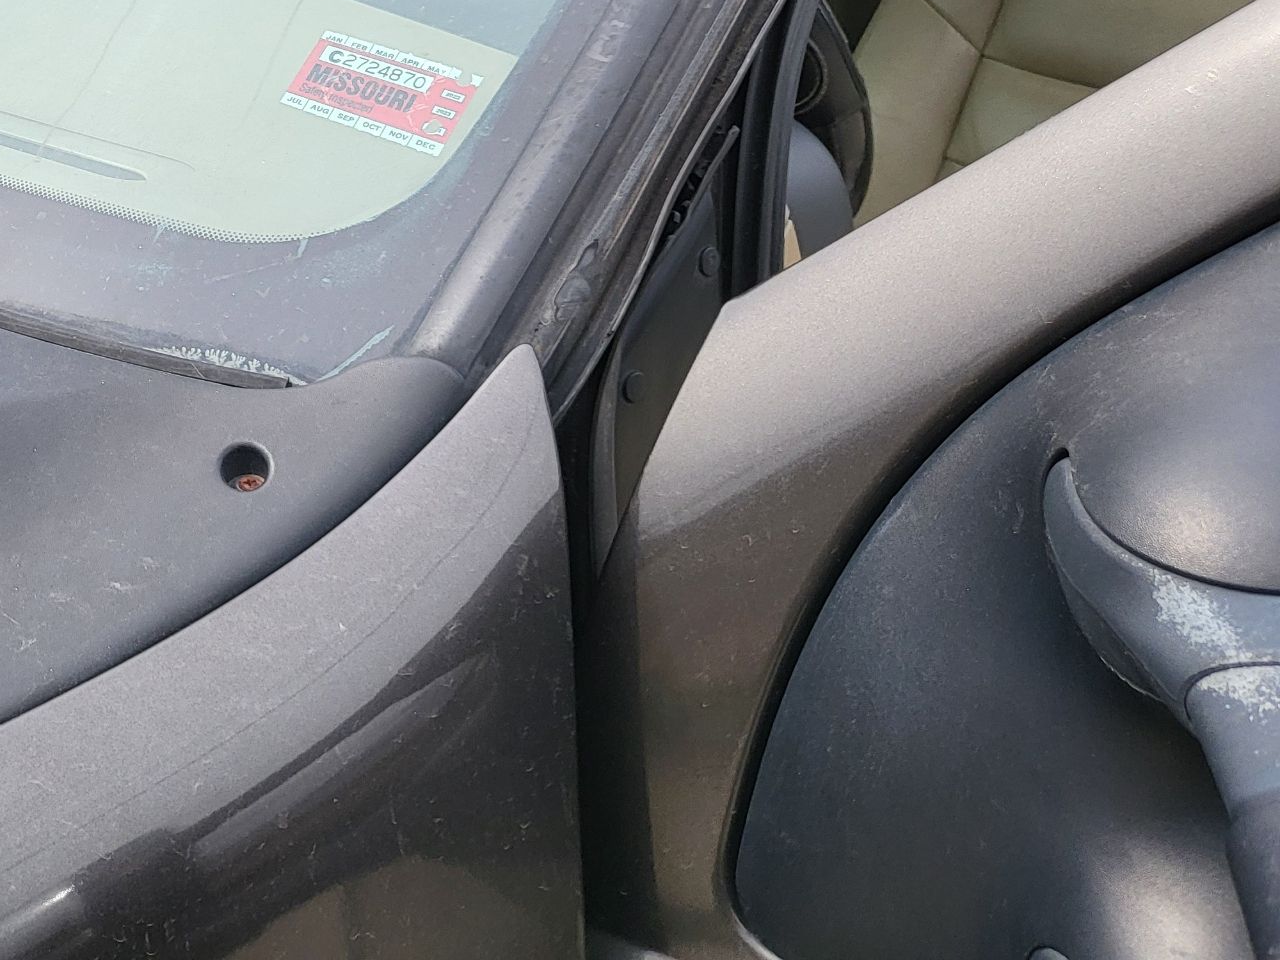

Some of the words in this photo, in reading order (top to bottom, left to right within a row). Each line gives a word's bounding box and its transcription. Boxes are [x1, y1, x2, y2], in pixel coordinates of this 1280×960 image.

[325, 34, 344, 43] JAN
[350, 42, 369, 51] FEB
[375, 49, 395, 60] MAR
[401, 57, 420, 67] APR
[427, 65, 447, 75] MAY
[328, 50, 427, 90] C2724870
[306, 62, 417, 113] MISSOURI
[286, 96, 304, 106] JUL
[310, 104, 330, 115] AUG
[337, 112, 355, 123] SEP
[362, 121, 382, 132] OCT
[388, 130, 409, 141] NOV
[415, 139, 436, 150] DEC
